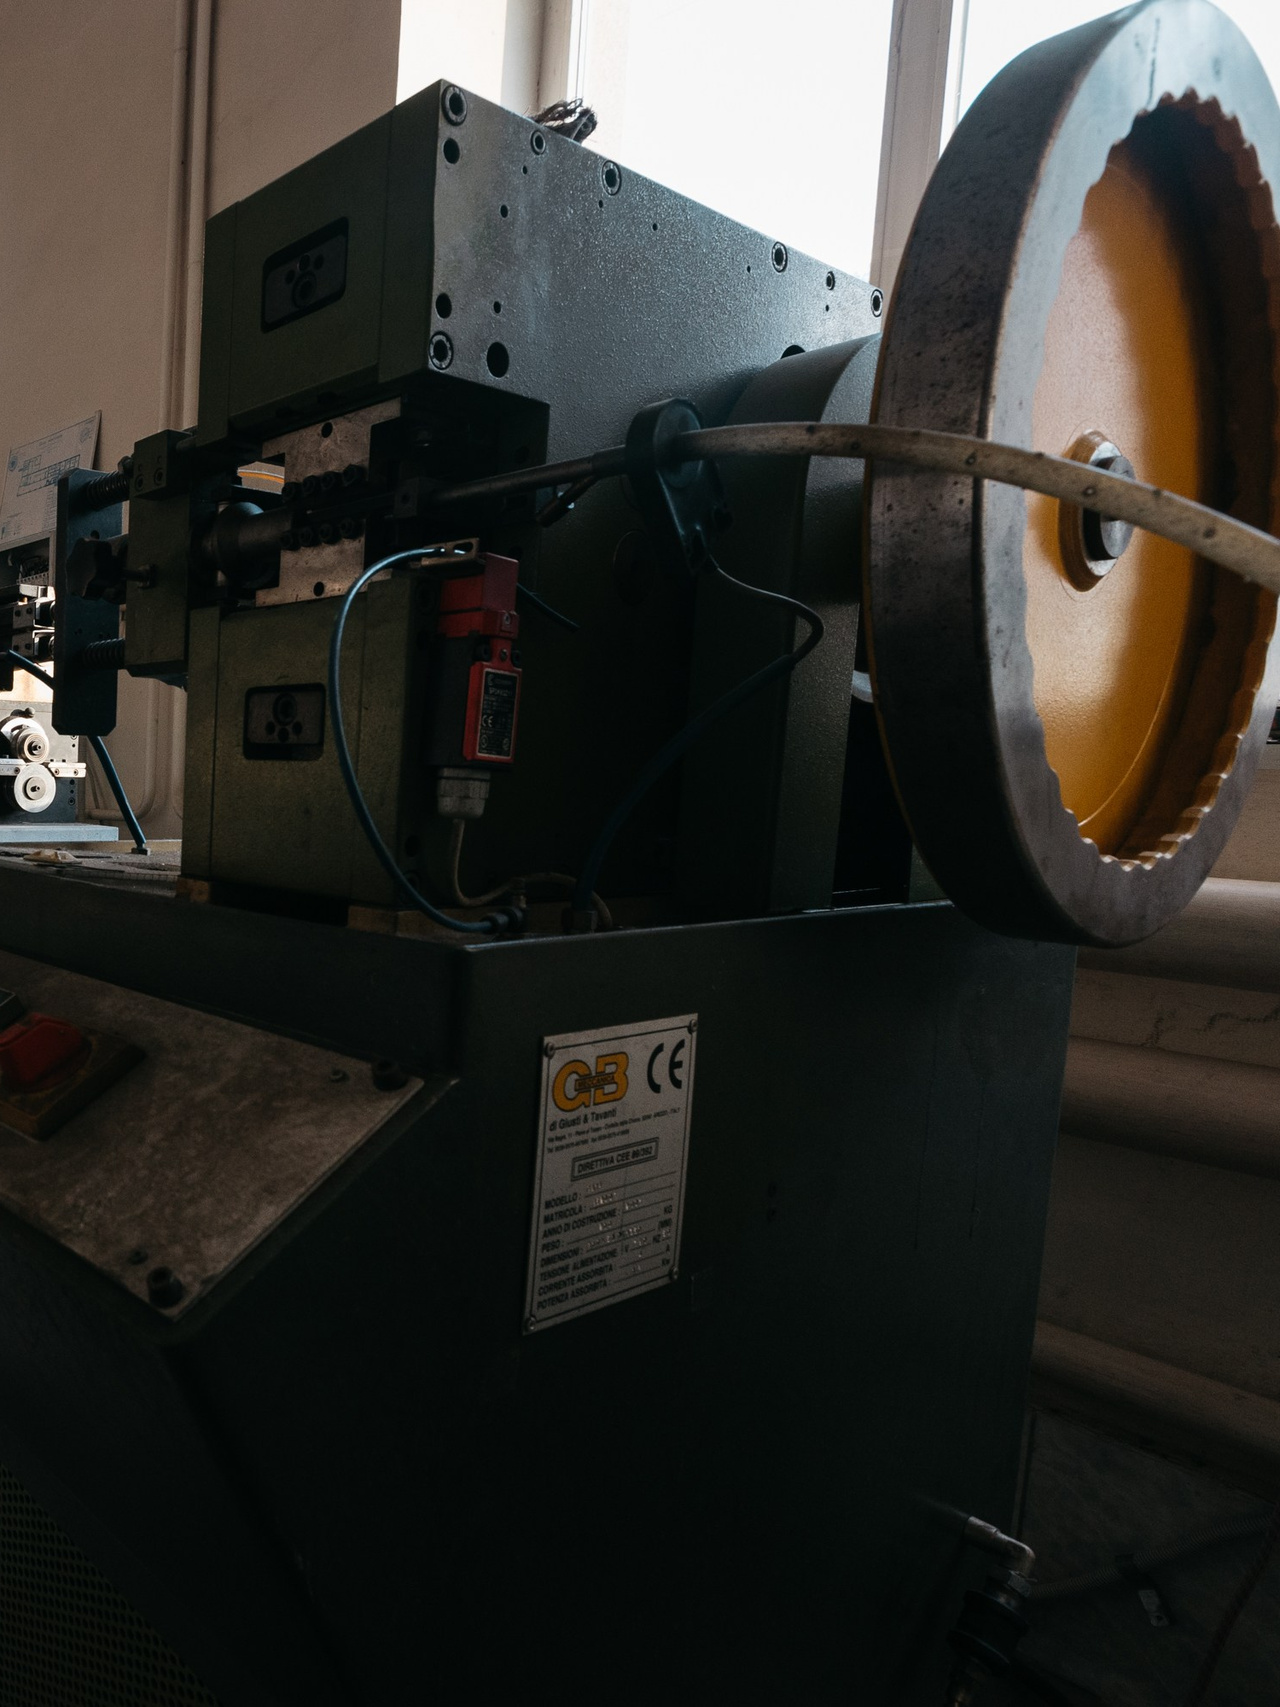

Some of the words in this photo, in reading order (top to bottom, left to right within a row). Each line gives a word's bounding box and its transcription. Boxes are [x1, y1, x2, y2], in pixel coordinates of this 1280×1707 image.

[481, 715, 493, 727] CE
[647, 1039, 685, 1094] CE
[551, 1051, 630, 1112] GB
[582, 1113, 588, 1124] &
[590, 1108, 617, 1122] Tavanti
[577, 1154, 615, 1174] DIRETTIVA
[615, 1151, 630, 1163] CEE
[663, 1204, 672, 1215] KG
[542, 1224, 562, 1239] ANNO
